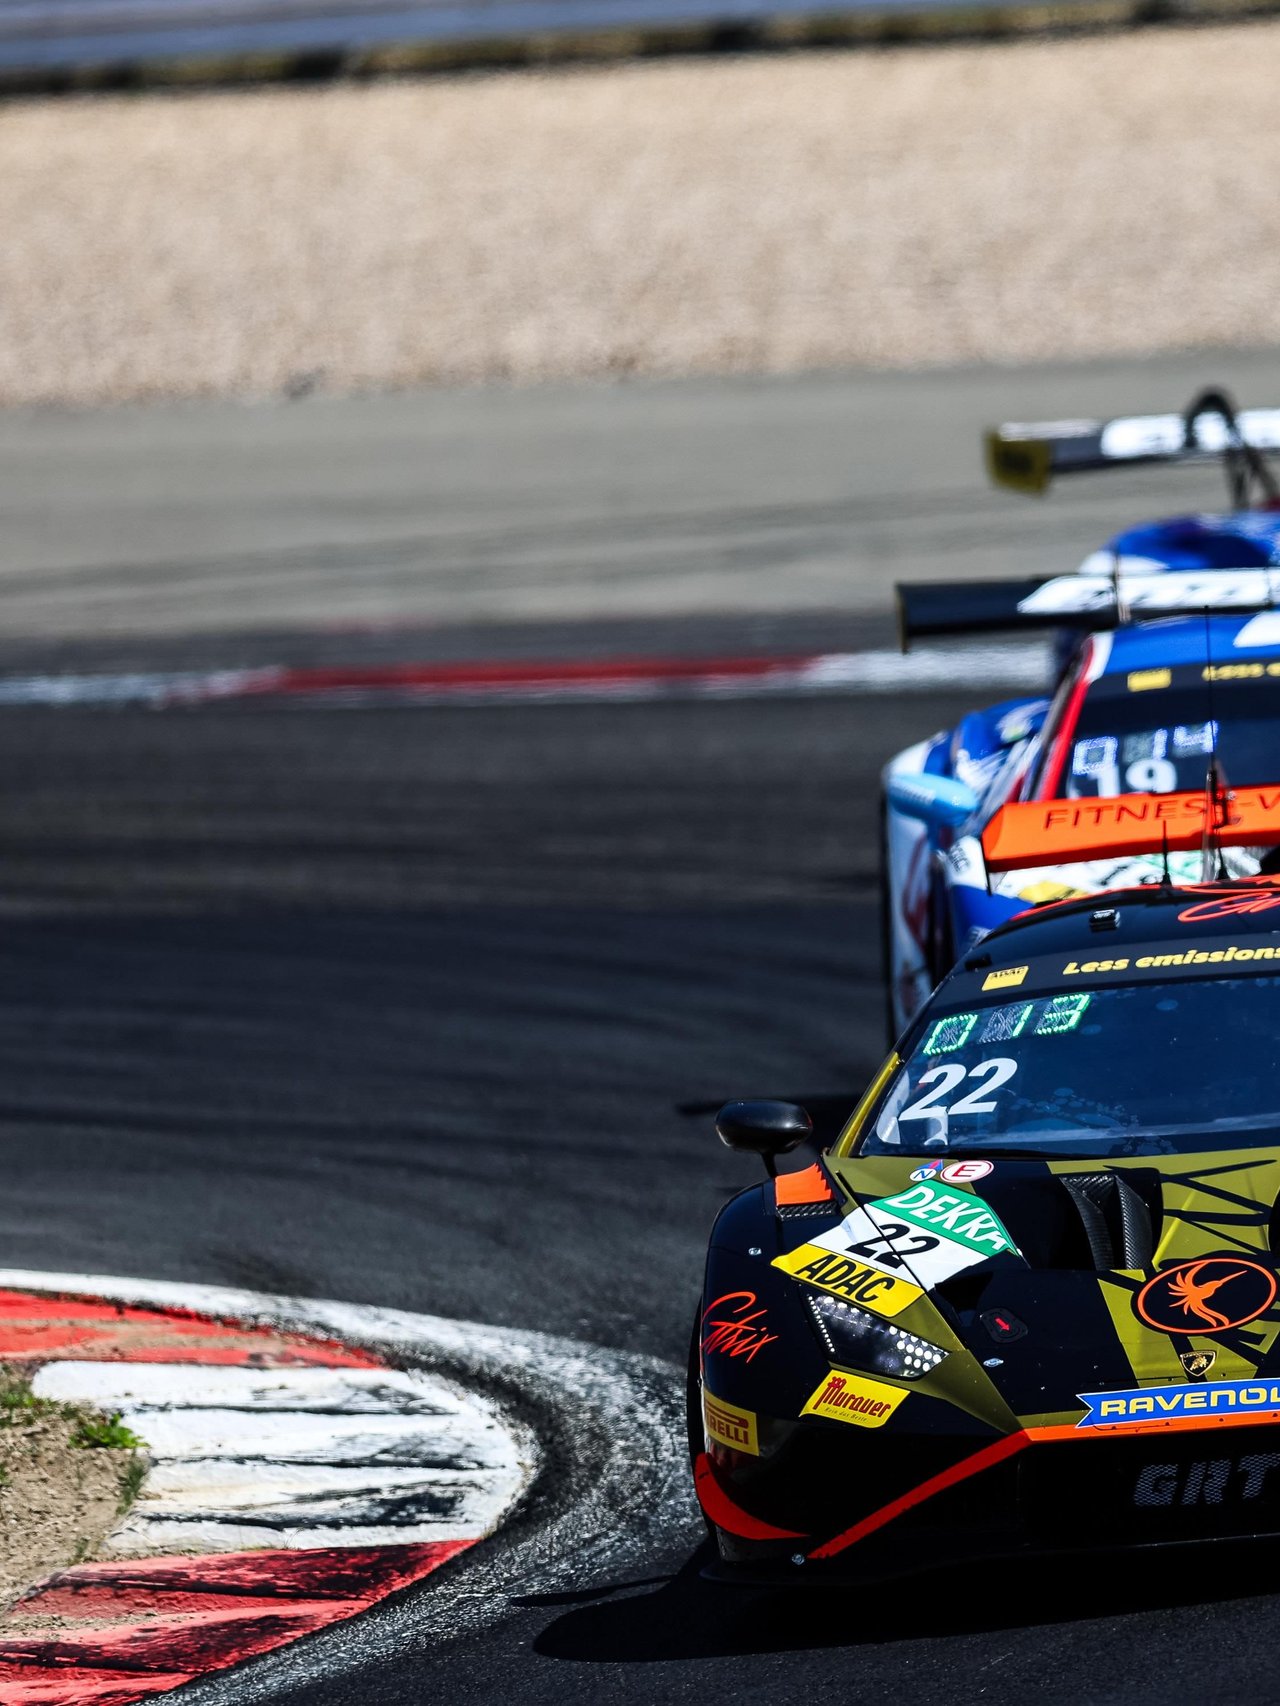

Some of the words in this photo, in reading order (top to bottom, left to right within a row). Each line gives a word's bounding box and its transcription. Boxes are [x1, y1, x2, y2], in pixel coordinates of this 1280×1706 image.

[1062, 957, 1131, 976] Less
[898, 1057, 1018, 1121] 22
[844, 1223, 941, 1269] 22
[794, 1253, 896, 1303] ADAC
[812, 1376, 891, 1417] Murauer
